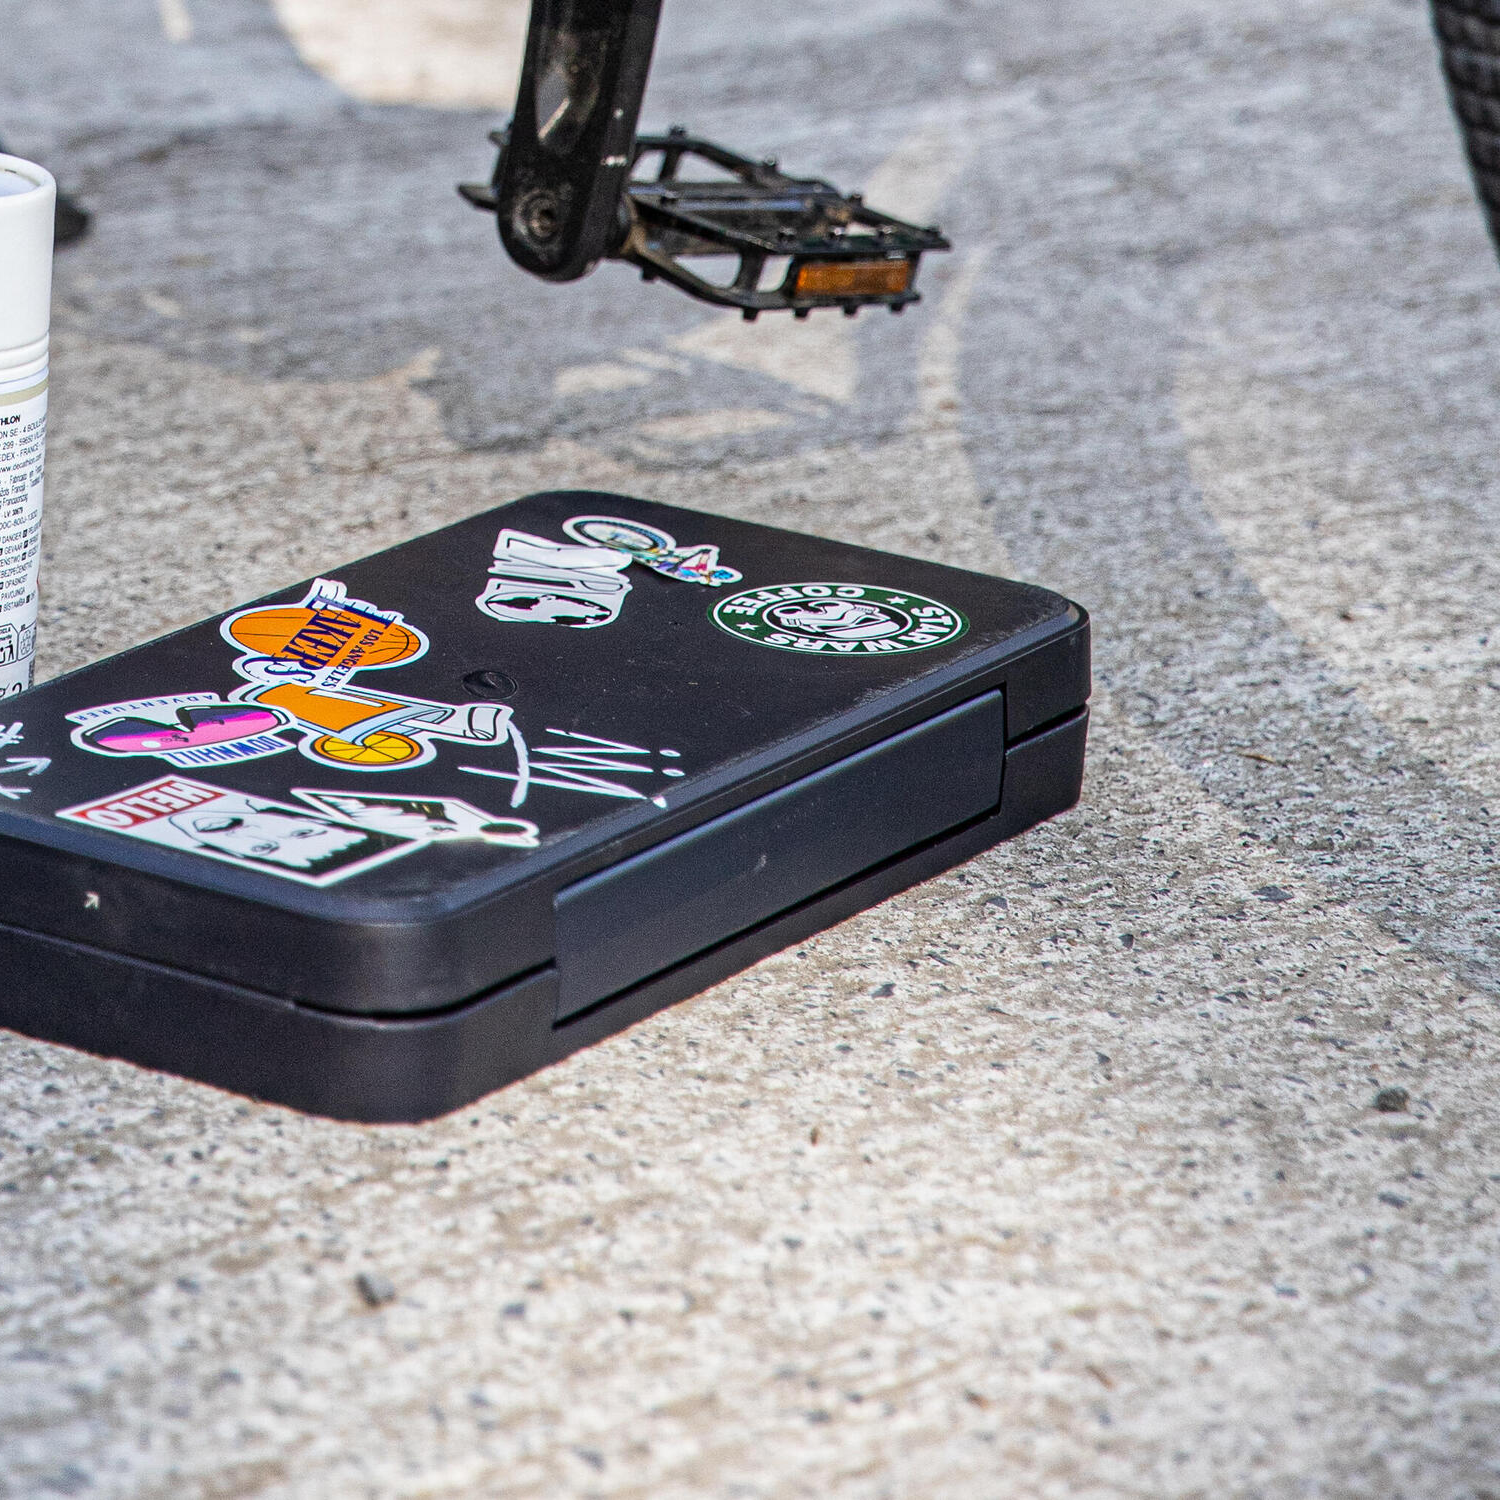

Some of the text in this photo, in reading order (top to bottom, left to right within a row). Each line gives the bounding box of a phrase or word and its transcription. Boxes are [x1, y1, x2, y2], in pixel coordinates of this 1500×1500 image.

[2, 441, 14, 451] 299
[9, 428, 19, 437] SE
[2, 533, 22, 545] DANGER
[723, 586, 865, 616] COFFEE
[242, 585, 398, 684] LAKERS
[764, 606, 953, 653] STAR WARS
[321, 629, 384, 689] LOS ANGELES
[74, 694, 213, 720] ADVENTURER
[162, 735, 287, 765] DOWNHILL
[86, 781, 216, 827] HELLO
